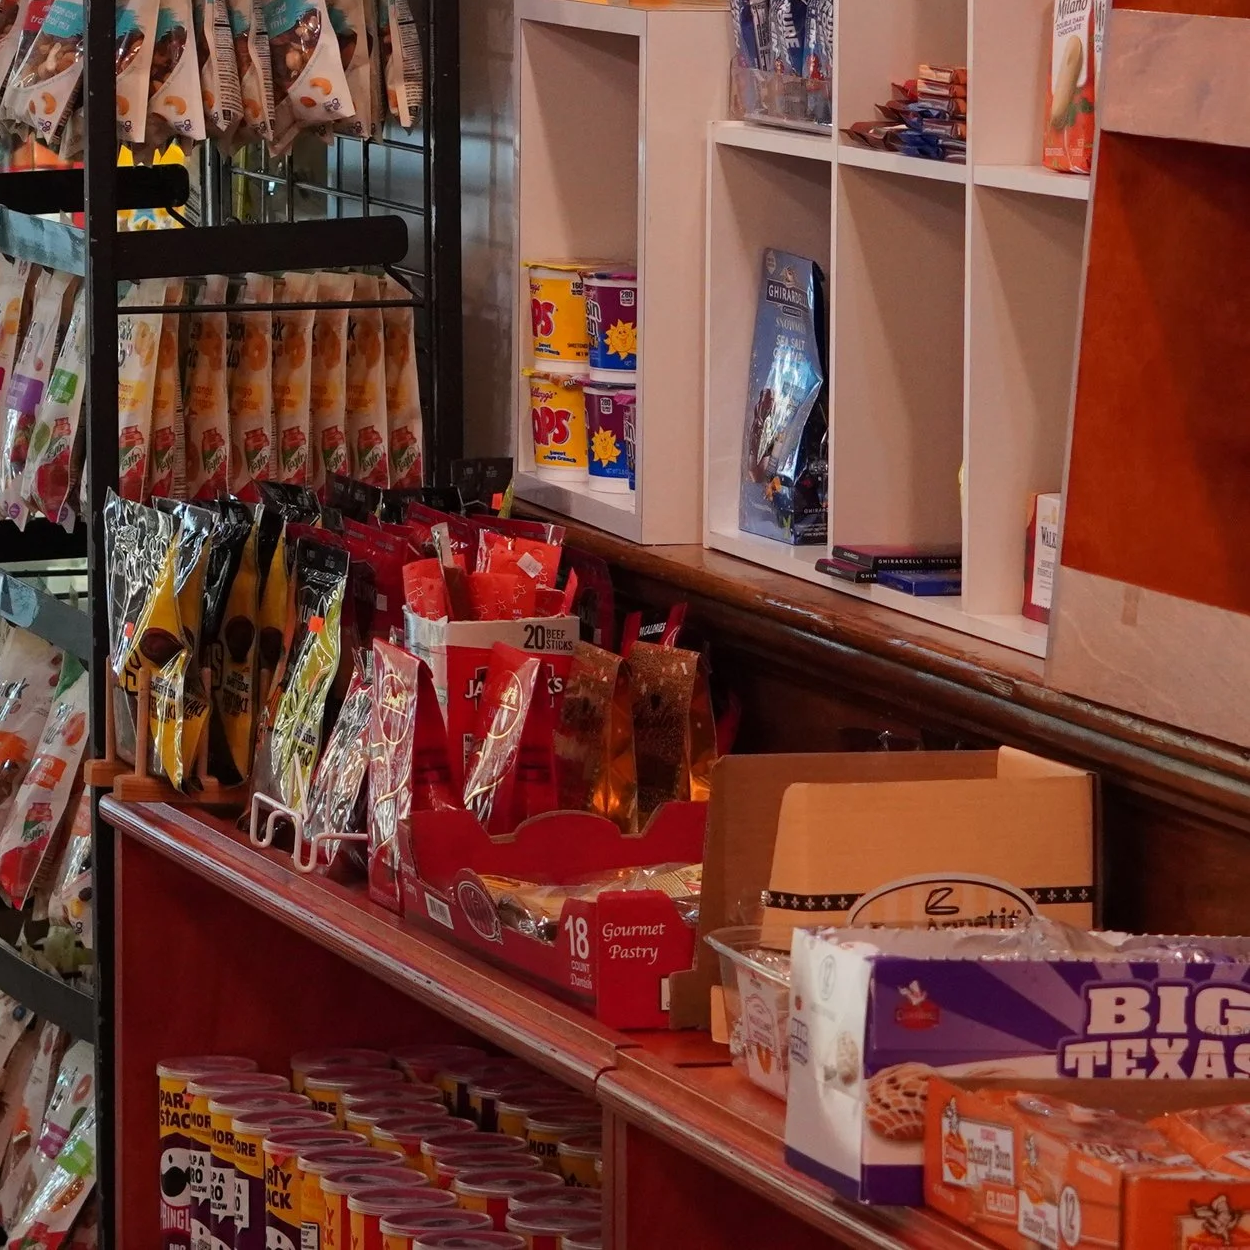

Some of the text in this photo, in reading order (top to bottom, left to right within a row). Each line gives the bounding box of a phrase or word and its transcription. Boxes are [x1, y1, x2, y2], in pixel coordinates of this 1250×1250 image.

[1056, 15, 1085, 30] DOUBLE DARK
[1057, 23, 1081, 37] CHOCOLATE
[776, 335, 805, 350] SEA SALT
[878, 557, 923, 565] GHIRARDELLI
[524, 623, 566, 650] 20 BEEF
[546, 639, 574, 652] STICKS
[564, 914, 590, 960] 18
[602, 922, 666, 942] Gourmet
[608, 945, 660, 965] Pastry
[570, 960, 591, 975] COUNT
[1087, 985, 1250, 1036] BIG
[160, 1109, 190, 1129] STAC
